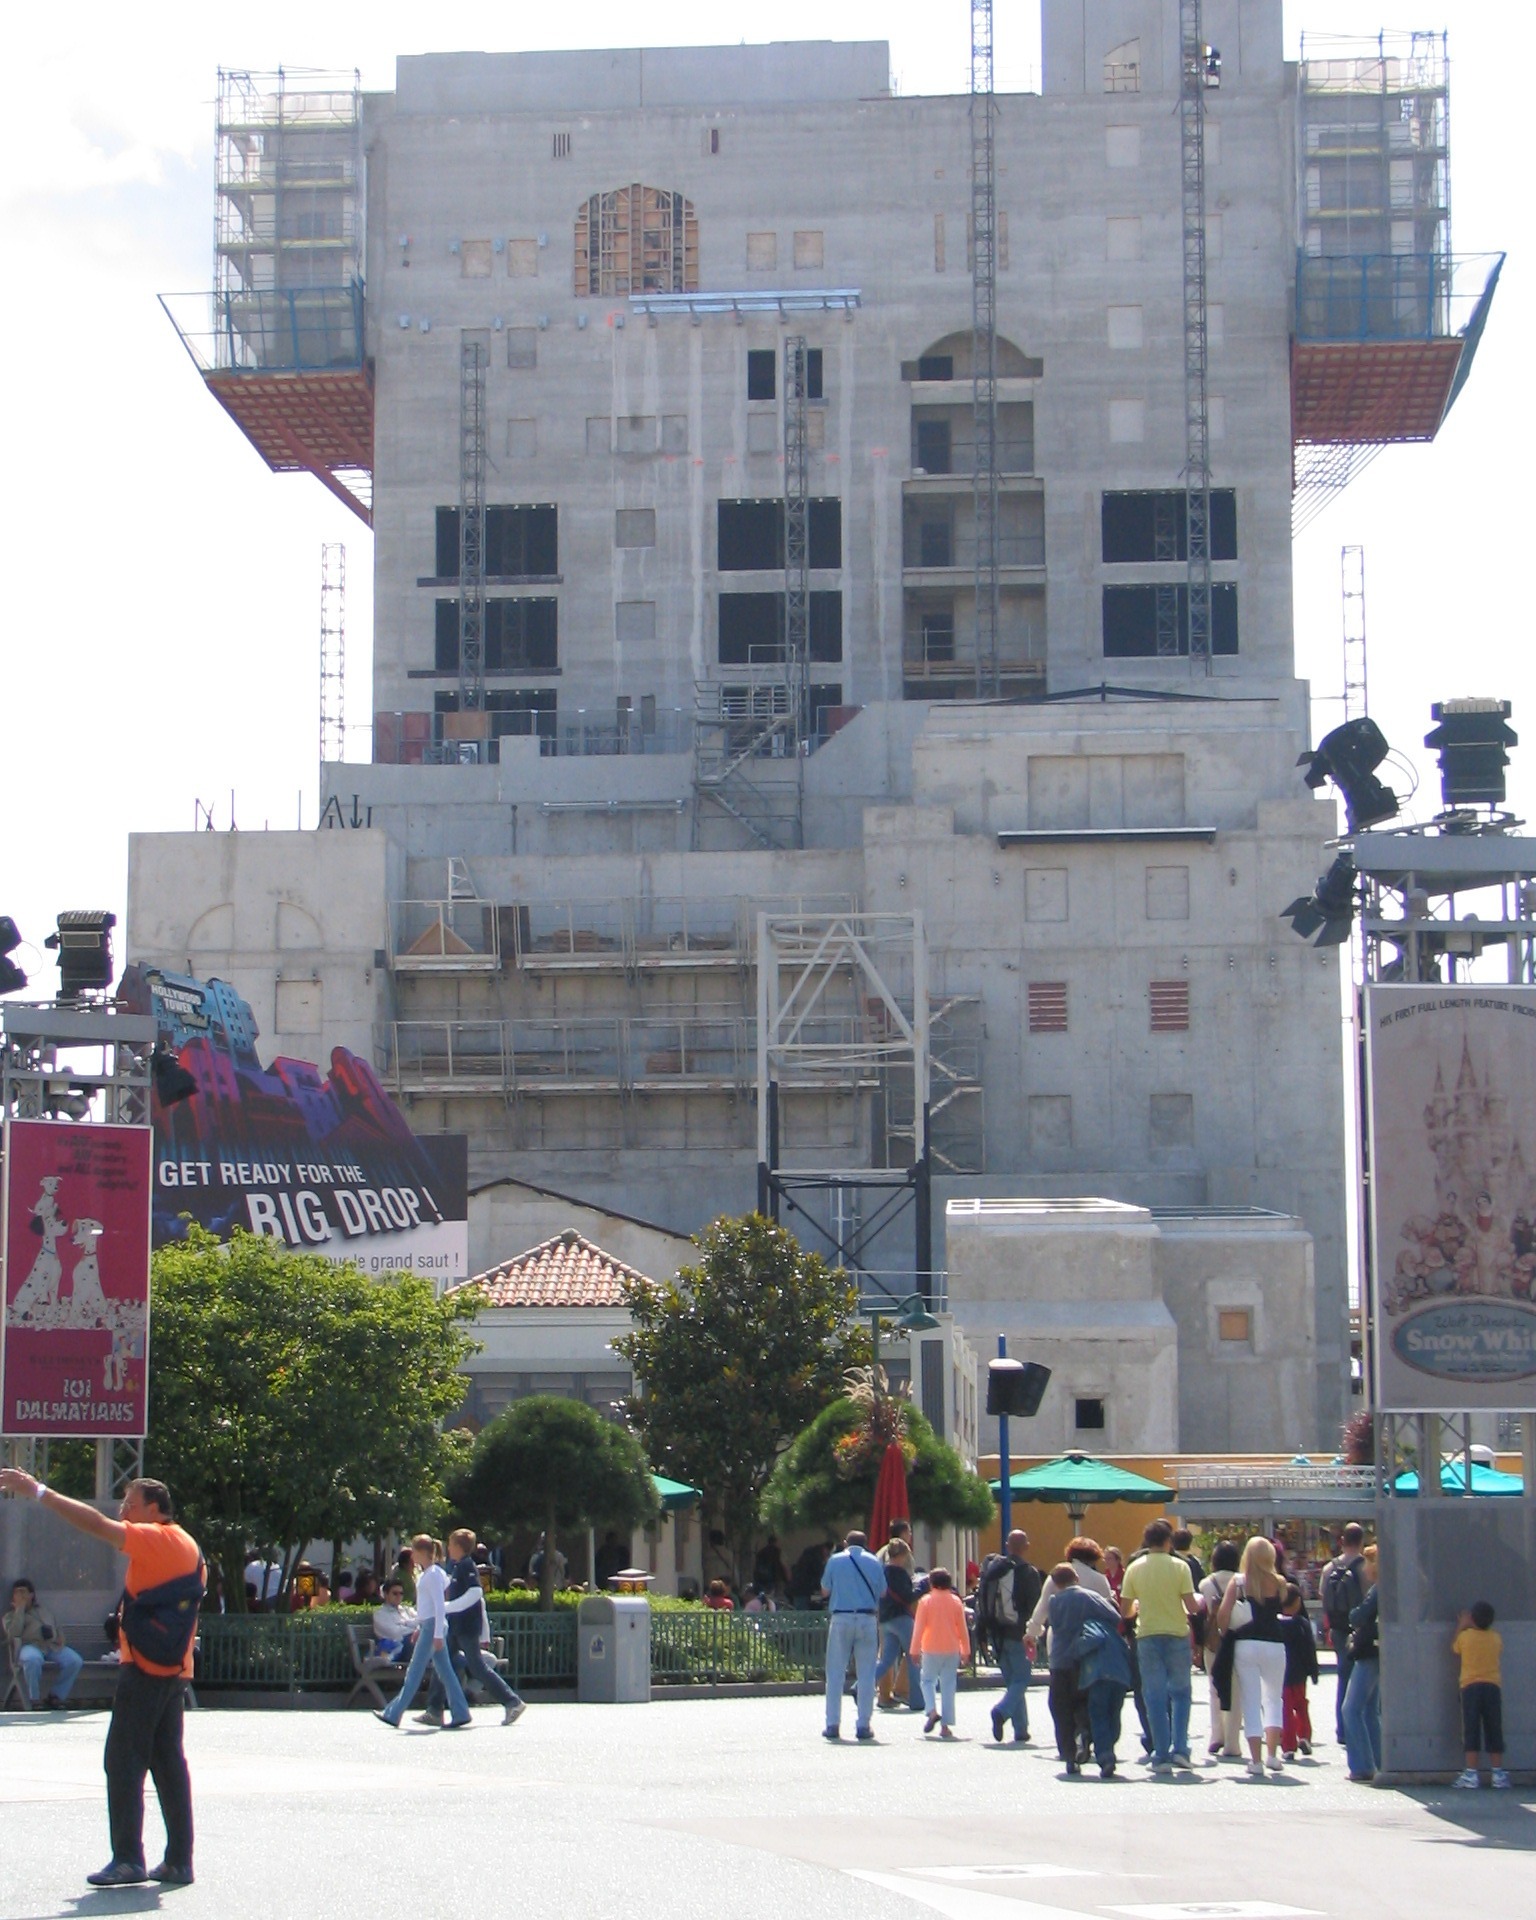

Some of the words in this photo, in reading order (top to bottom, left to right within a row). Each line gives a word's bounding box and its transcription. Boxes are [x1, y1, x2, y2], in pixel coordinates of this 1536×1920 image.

[1417, 1002, 1437, 1014] FULL
[1439, 999, 1470, 1009] LENGTH
[1474, 999, 1509, 1011] FEATURE
[158, 1160, 211, 1187] GET
[219, 1162, 292, 1186] READY
[296, 1164, 335, 1184] FOR
[334, 1165, 367, 1183] THE
[245, 1190, 332, 1246] BIG
[370, 1252, 413, 1272] grand
[417, 1253, 449, 1269] saut
[1406, 1328, 1478, 1352] Snow
[63, 1379, 91, 1398] 101
[16, 1400, 135, 1421] DALMATIANS
